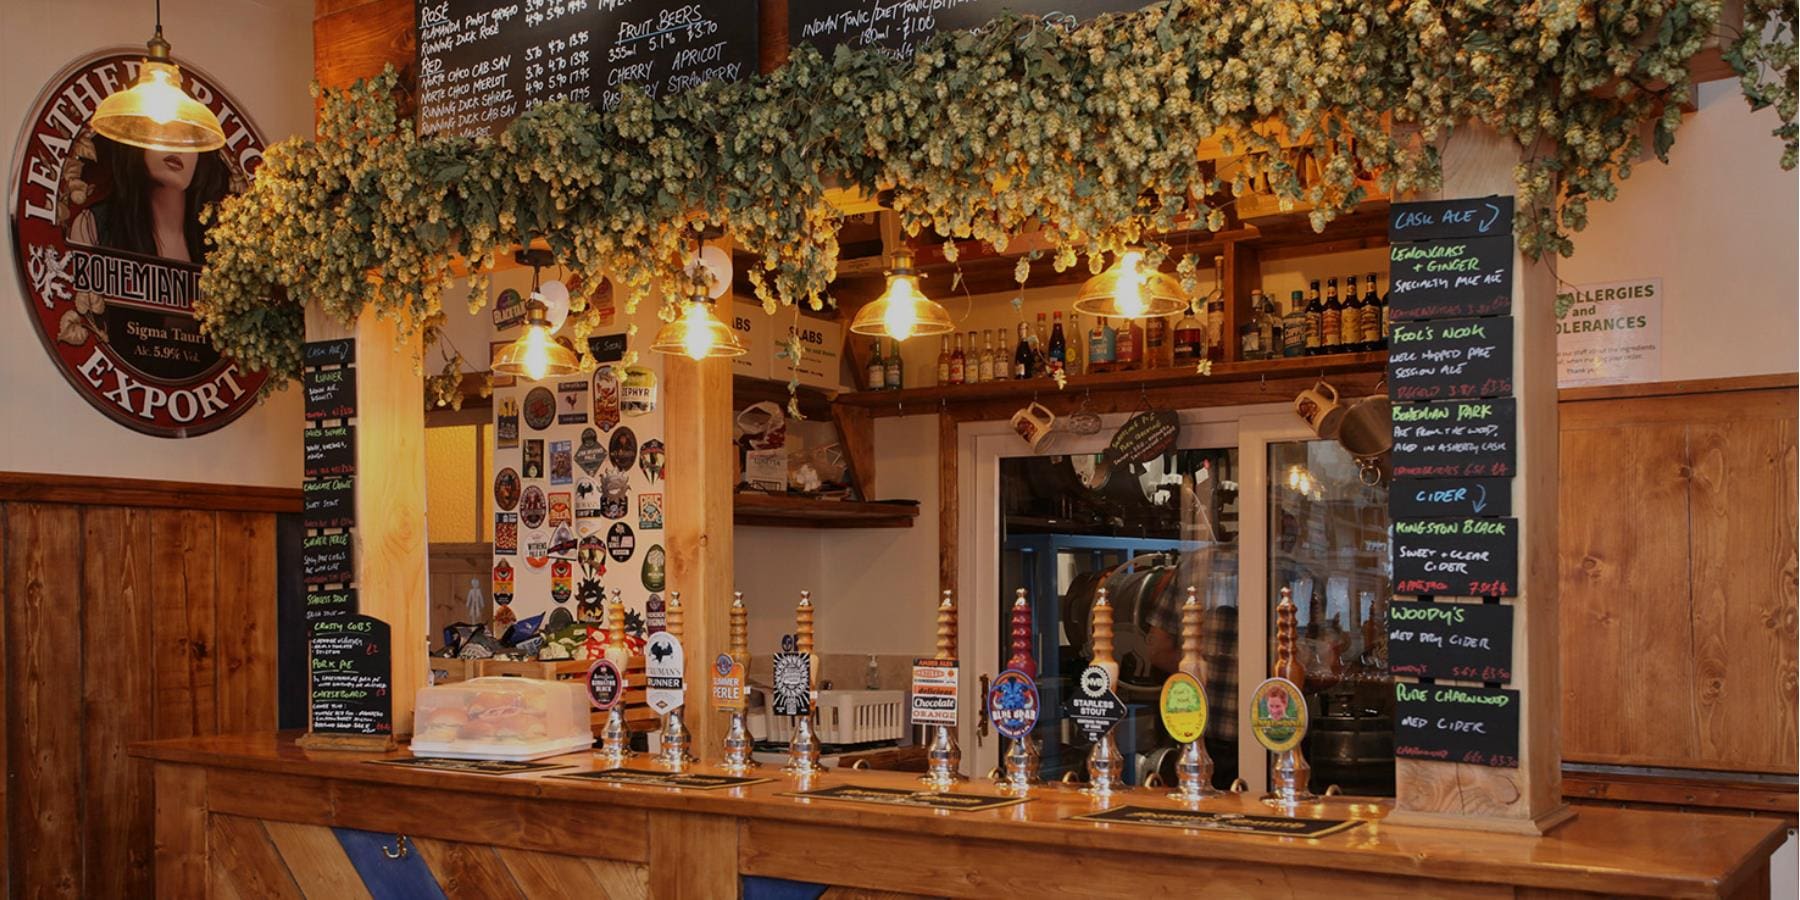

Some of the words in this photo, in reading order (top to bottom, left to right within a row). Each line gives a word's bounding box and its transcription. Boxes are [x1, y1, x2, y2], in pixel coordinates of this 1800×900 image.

[617, 19, 653, 43] FRUIT
[656, 4, 703, 31] BEERS
[802, 14, 837, 38] INDIAN
[421, 38, 453, 58] RUNNING
[456, 32, 477, 47] DUCK
[859, 26, 890, 46] 180ml
[608, 43, 637, 63] 355ml
[421, 57, 444, 76] RED
[448, 68, 469, 83] CHICO
[472, 61, 489, 80] CAB
[491, 54, 511, 73] SAV
[607, 60, 654, 87] CHERRY
[671, 41, 728, 71] APRICOT
[667, 62, 742, 94] STRAWBERRY
[421, 91, 445, 105] NORTE
[448, 83, 469, 98] CHICO
[473, 74, 508, 94] MERLOT
[422, 102, 456, 120] RUNNING
[459, 97, 478, 112] DUCK
[481, 89, 514, 106] SHIRAZ
[458, 112, 478, 128] DUCK
[481, 106, 498, 122] CAB
[499, 102, 517, 119] SAV
[1395, 211, 1434, 230] CASK
[1442, 209, 1477, 224] ALE
[1391, 245, 1466, 262] LEMONGRASS
[1427, 257, 1480, 273] GINGER
[74, 252, 194, 308] BOHEMIAN
[1394, 276, 1448, 293] SPECIALTY
[1455, 276, 1481, 290] PALE
[1484, 269, 1504, 284] ALE
[1572, 305, 1597, 318] and
[126, 321, 168, 341] Sigma
[171, 325, 206, 344] Tauri
[1393, 326, 1434, 345] FOOL'S
[1442, 324, 1486, 340] NOOK
[153, 345, 181, 361] 5.9%
[1422, 348, 1462, 364] HOPPED
[1467, 346, 1496, 361] PALE
[1395, 367, 1435, 380] SESSION
[1440, 362, 1467, 376] ALE
[76, 345, 245, 423] EXPORT
[1392, 406, 1449, 422] BOHEMIAN
[1415, 426, 1444, 437] FROM
[1481, 442, 1506, 452] CASK
[1416, 487, 1467, 503] CIDER
[1395, 521, 1458, 535] KINGSTON
[1462, 519, 1506, 537] BLACK
[1399, 546, 1437, 559] SWEET
[1450, 549, 1490, 562] CLEAR
[1423, 561, 1468, 575] CIDER
[1391, 606, 1466, 627] WOODY'S
[347, 622, 372, 632] COBS
[1390, 630, 1414, 641] MED
[1419, 632, 1443, 648] DRY
[1449, 634, 1491, 650] CIDER
[312, 658, 336, 669] PORK
[340, 660, 354, 669] PIE
[648, 677, 680, 688] RUNNER
[312, 690, 368, 699] CHEESEBOARD
[713, 687, 740, 700] PERLE
[1396, 683, 1429, 703] PURE
[1434, 688, 1510, 708] CHARNWOOD
[914, 698, 955, 708] Chocolate
[1073, 699, 1115, 709] STARLESS
[1080, 707, 1107, 716] STOUT
[912, 710, 956, 720] ORANGE
[1401, 716, 1428, 728] MED
[1436, 717, 1488, 735] CIDER
